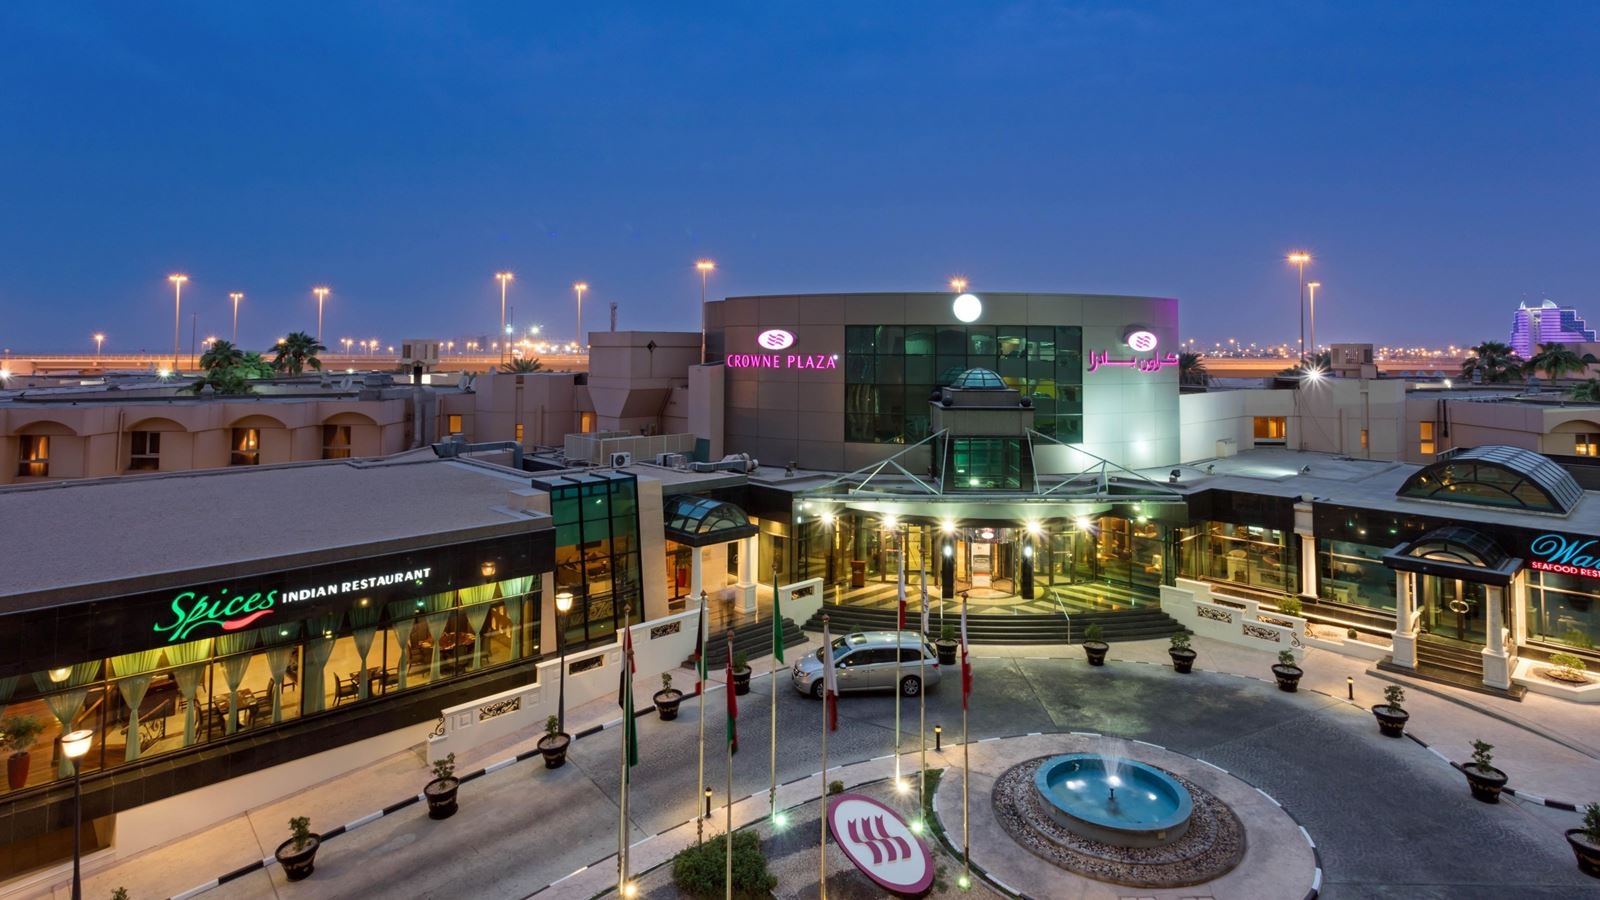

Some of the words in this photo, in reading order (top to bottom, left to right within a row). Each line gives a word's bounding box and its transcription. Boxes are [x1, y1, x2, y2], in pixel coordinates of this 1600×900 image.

[727, 354, 780, 368] CROWNE
[787, 355, 836, 369] PLAZA
[1088, 350, 1137, 372] بلازا
[1140, 351, 1180, 372] كراون
[1531, 561, 1578, 574] SEAFOOD
[153, 588, 278, 641] Spices
[282, 584, 337, 603] INDIAN
[341, 567, 431, 593] RESTAURANT
